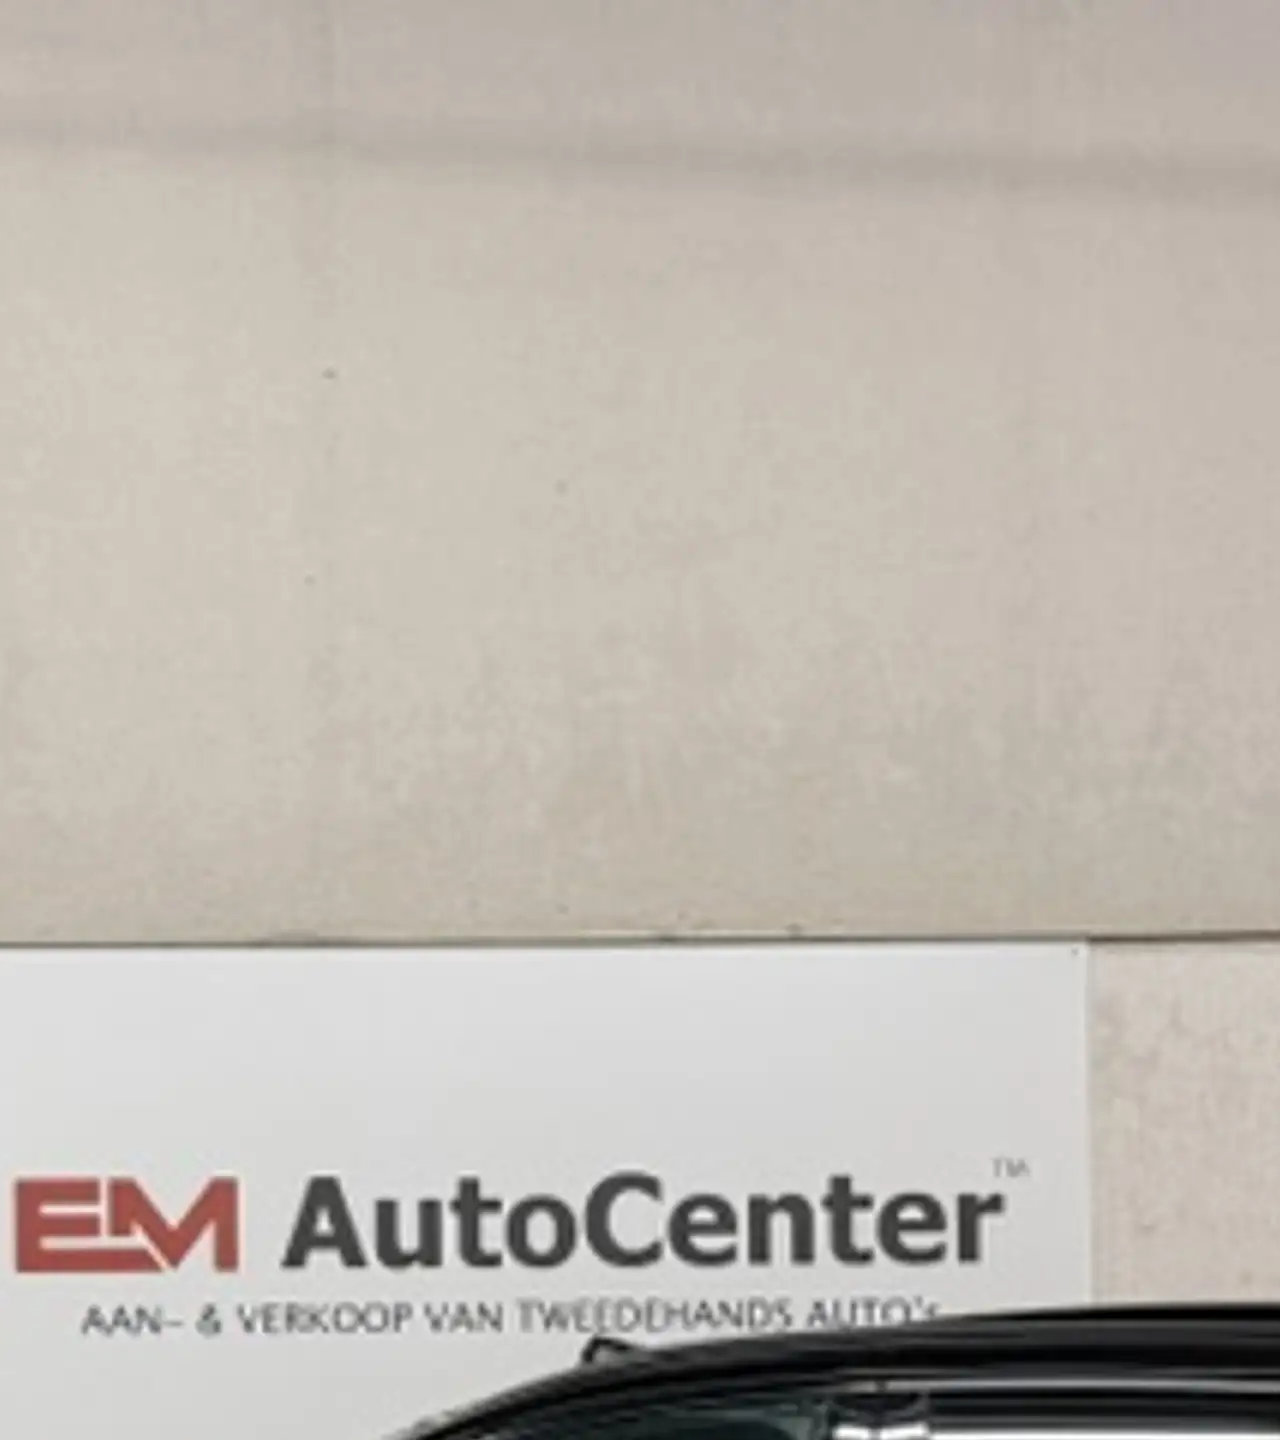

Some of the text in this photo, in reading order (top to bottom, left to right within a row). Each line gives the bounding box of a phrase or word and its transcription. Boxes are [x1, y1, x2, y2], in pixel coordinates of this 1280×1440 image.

[15, 1177, 238, 1272] EM
[281, 1169, 1005, 1268] AutoCenter
[195, 1303, 221, 1338] &
[236, 1301, 415, 1335] VERKOOP
[423, 1302, 505, 1335] VAN
[518, 1297, 793, 1334] TWEEDEHANDS
